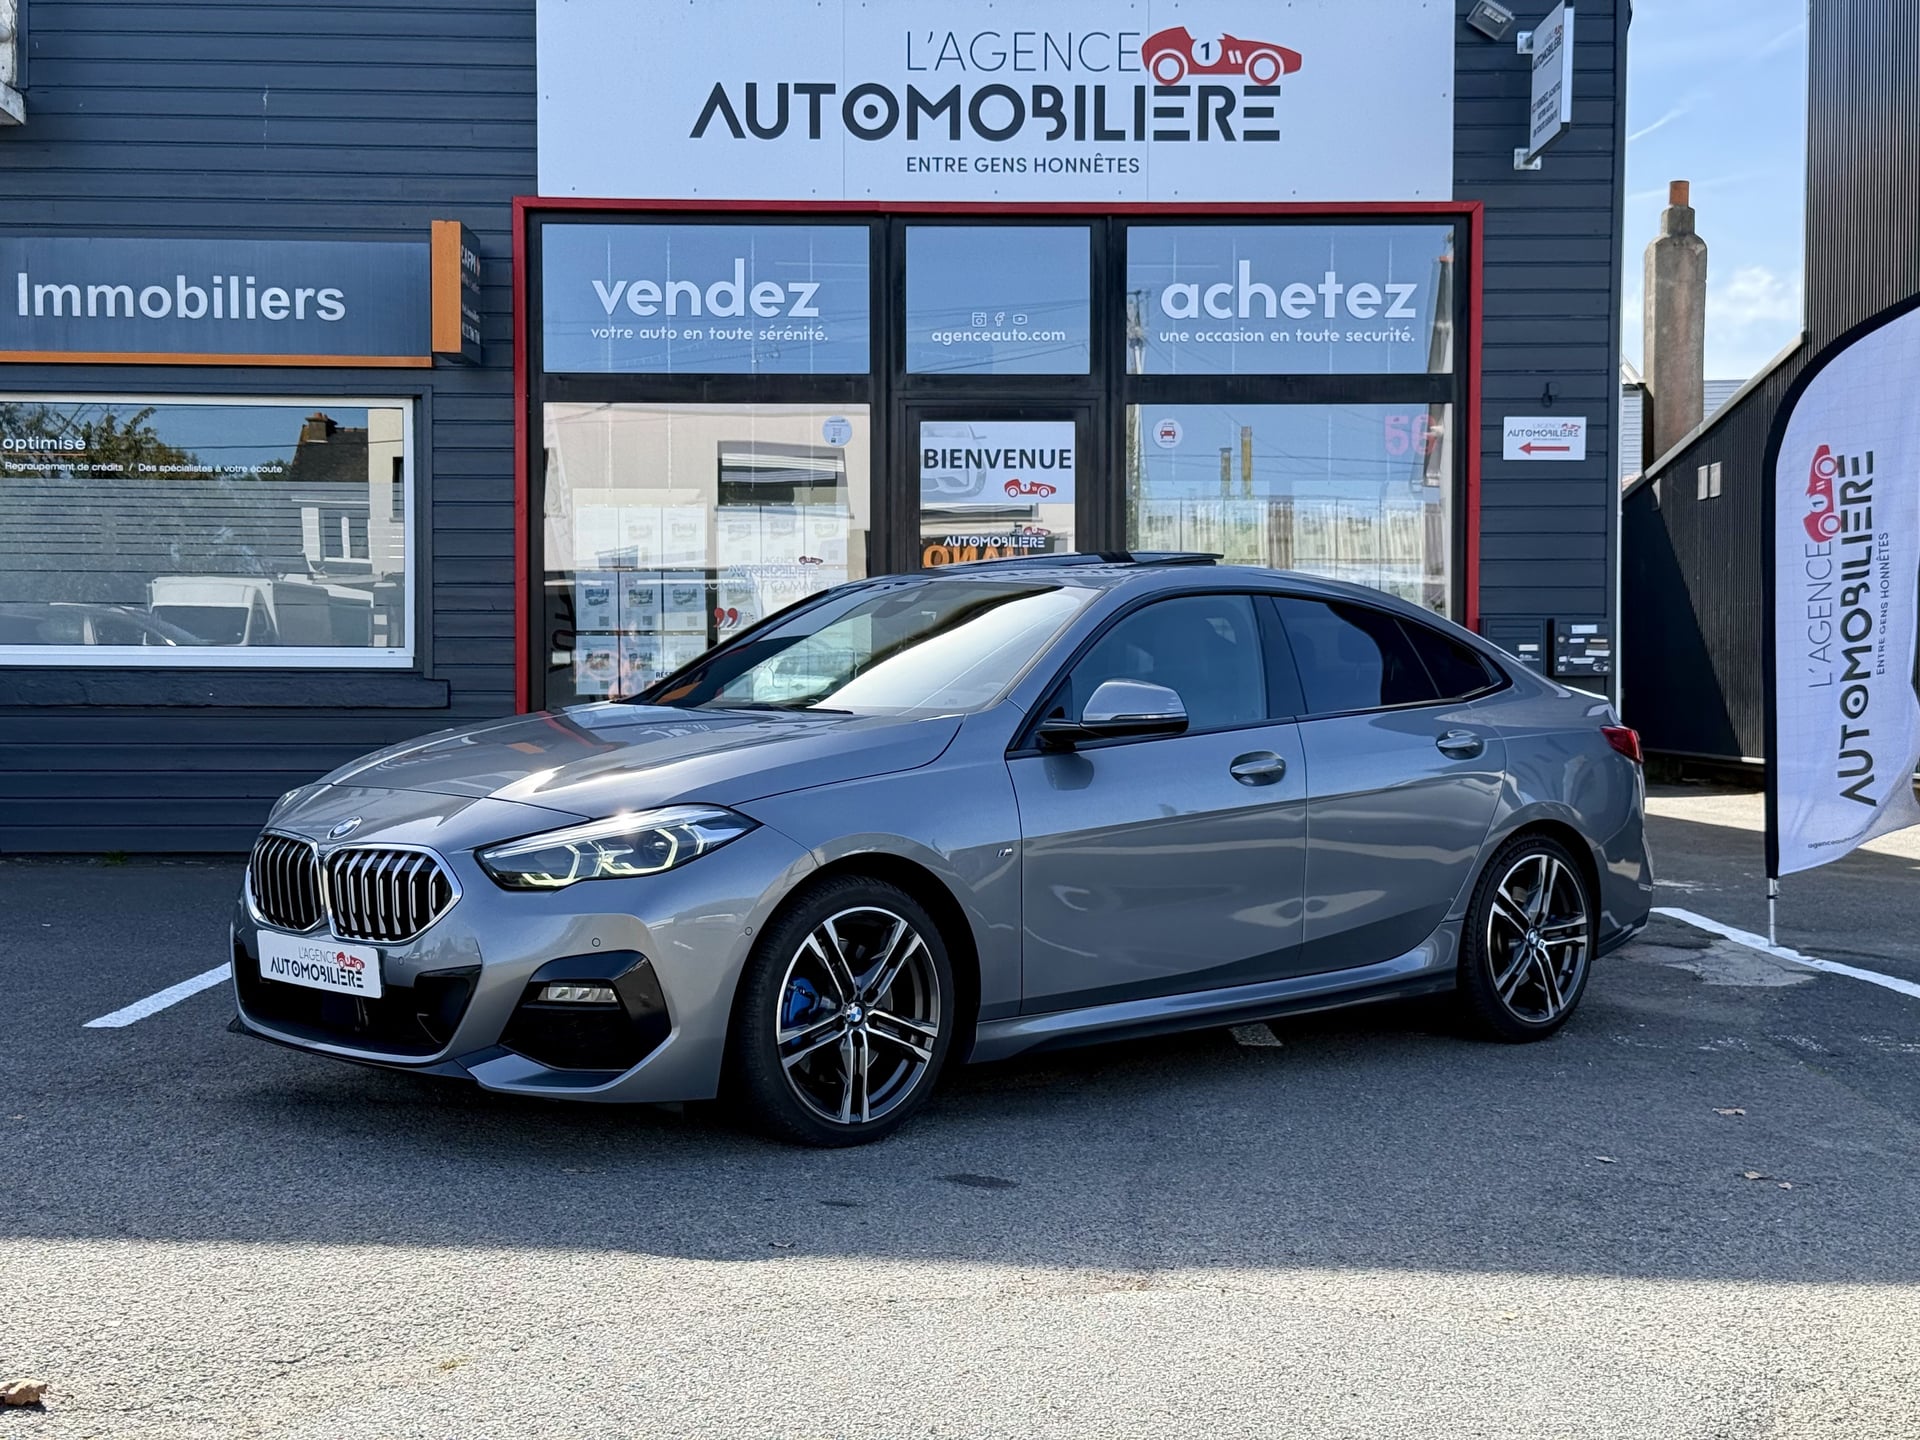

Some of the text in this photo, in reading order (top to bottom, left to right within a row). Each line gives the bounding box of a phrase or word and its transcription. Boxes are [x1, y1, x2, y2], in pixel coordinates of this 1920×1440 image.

[907, 31, 1141, 72] L'AGENCE
[907, 152, 1140, 173] ENTRE GENS HONNÊTES
[17, 272, 347, 320] Immobiliers
[591, 258, 821, 318] vendez
[1160, 259, 1418, 319] achetez
[591, 324, 829, 342] votre auto en toute sérénité.
[931, 328, 1066, 346] agenceauto.com
[1159, 325, 1415, 343] une occasion en toute securité.
[2, 436, 87, 452] optimisé
[5, 461, 76, 473] Regroupement
[77, 461, 90, 472] de
[91, 461, 124, 472] crédits
[138, 463, 157, 473] Des
[159, 463, 213, 474] spécialistes
[215, 462, 222, 473] à
[224, 464, 248, 474] votre
[250, 462, 283, 474] écoute
[923, 448, 1072, 469] BIENVENUE
[1876, 532, 1890, 676] ENTRE GENS HONNÊTES
[1805, 541, 1833, 689] L'AGENCE
[298, 946, 337, 965] L'AGENCE
